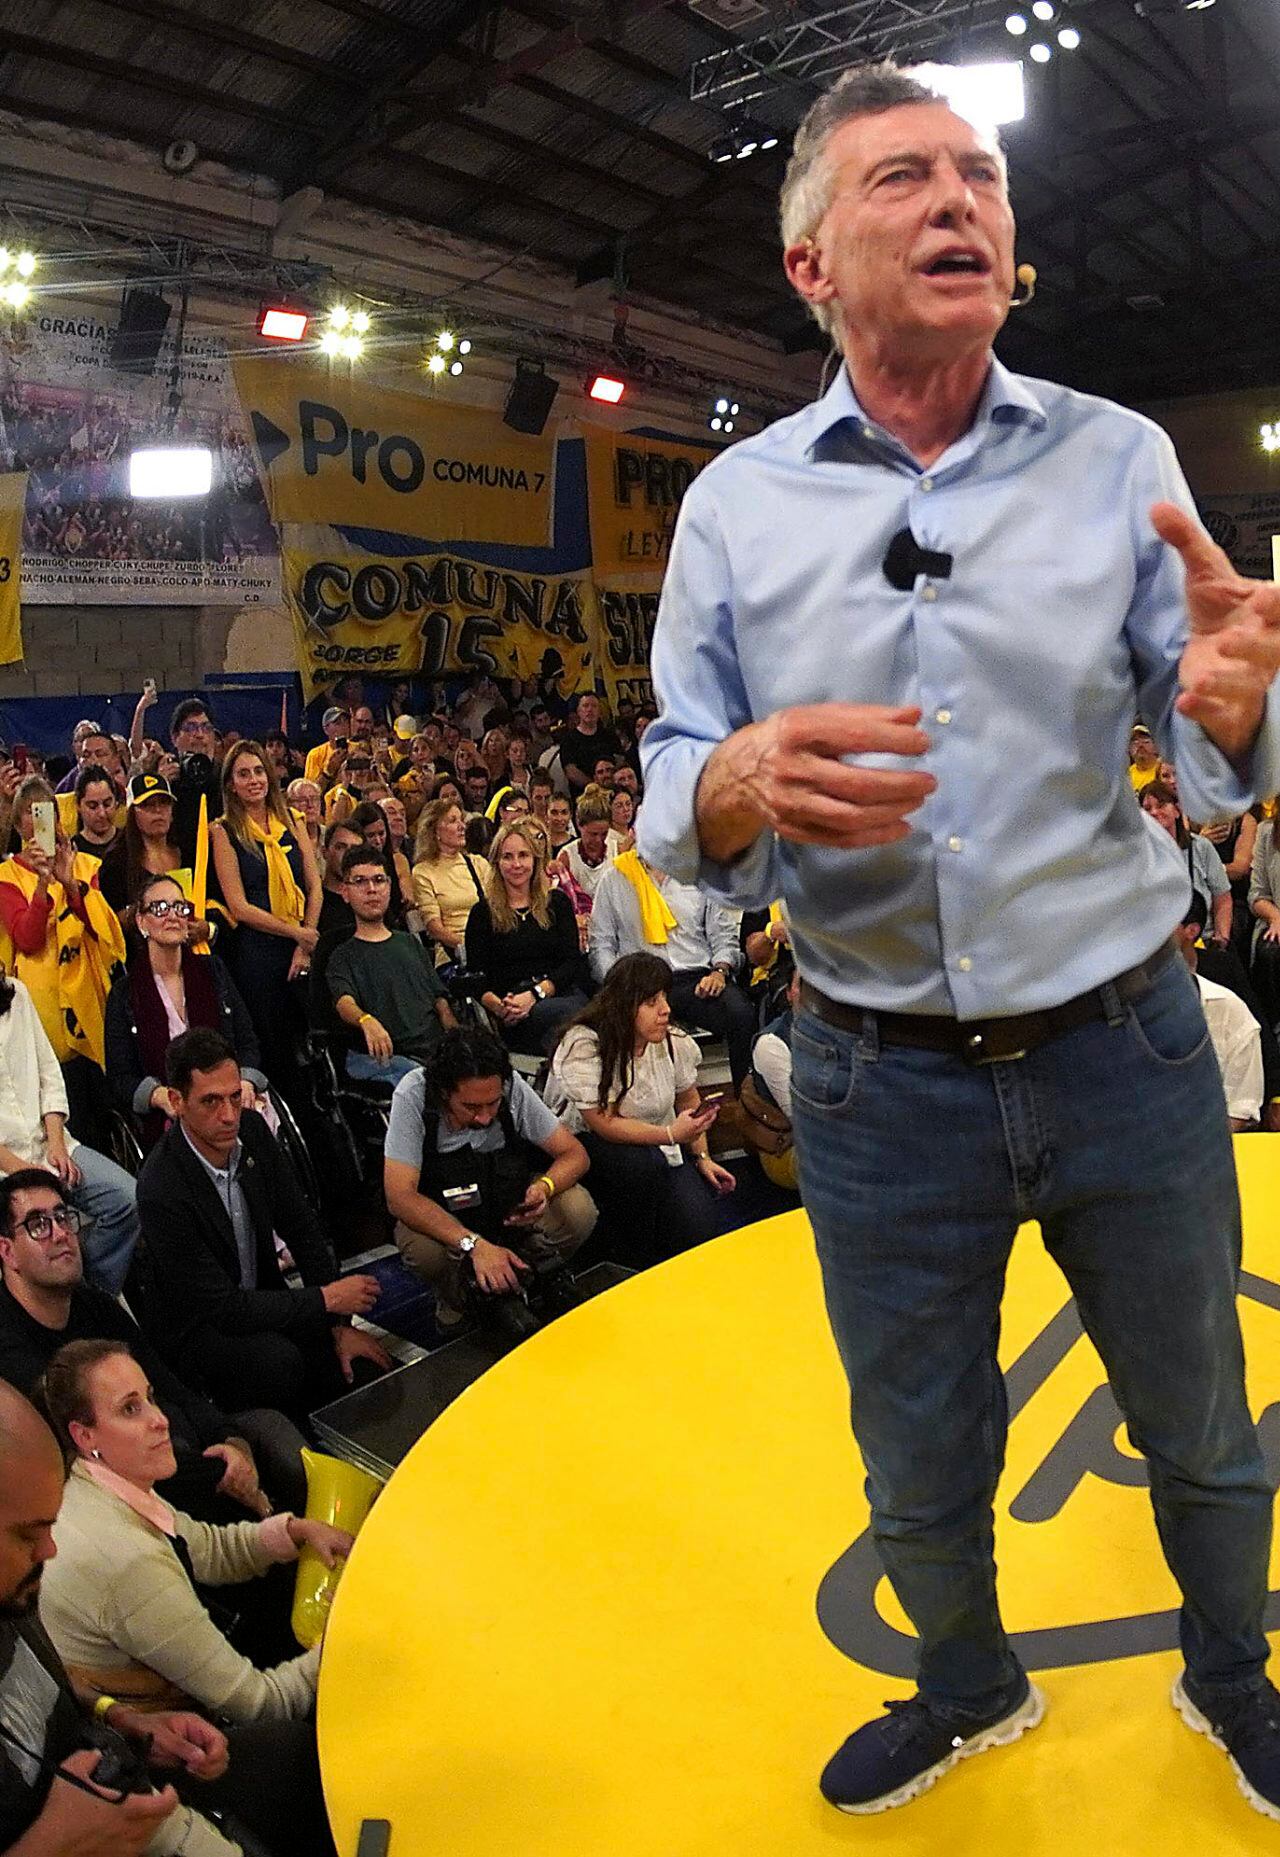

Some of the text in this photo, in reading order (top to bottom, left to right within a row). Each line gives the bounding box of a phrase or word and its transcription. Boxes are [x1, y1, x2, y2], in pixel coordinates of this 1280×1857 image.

[299, 400, 545, 494] Pro COMUNA 7
[302, 558, 588, 645] COMUNA
[419, 611, 504, 675] 15
